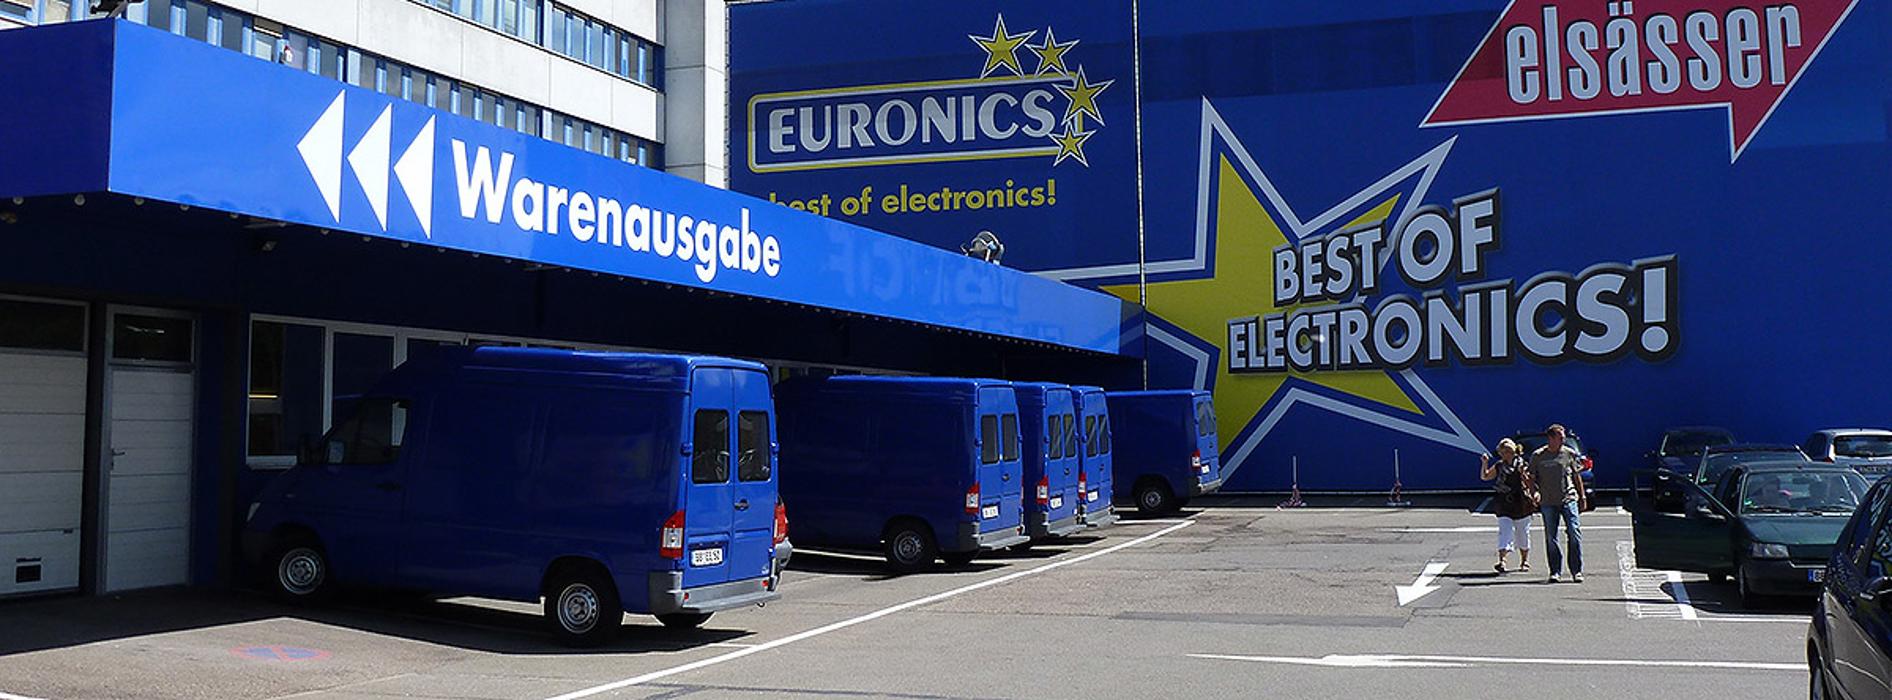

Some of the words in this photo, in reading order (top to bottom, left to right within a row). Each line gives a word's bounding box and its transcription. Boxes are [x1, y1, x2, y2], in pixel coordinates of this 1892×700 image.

[1507, 1, 1802, 103] elsässer
[769, 89, 1056, 154] EURONICS
[452, 138, 782, 283] Warenausgabe
[841, 186, 872, 216] of
[882, 179, 1057, 213] electronics!
[1274, 223, 1384, 305] BEST
[1398, 190, 1498, 285] OF
[1228, 259, 1674, 371] ELECTRONICS!
